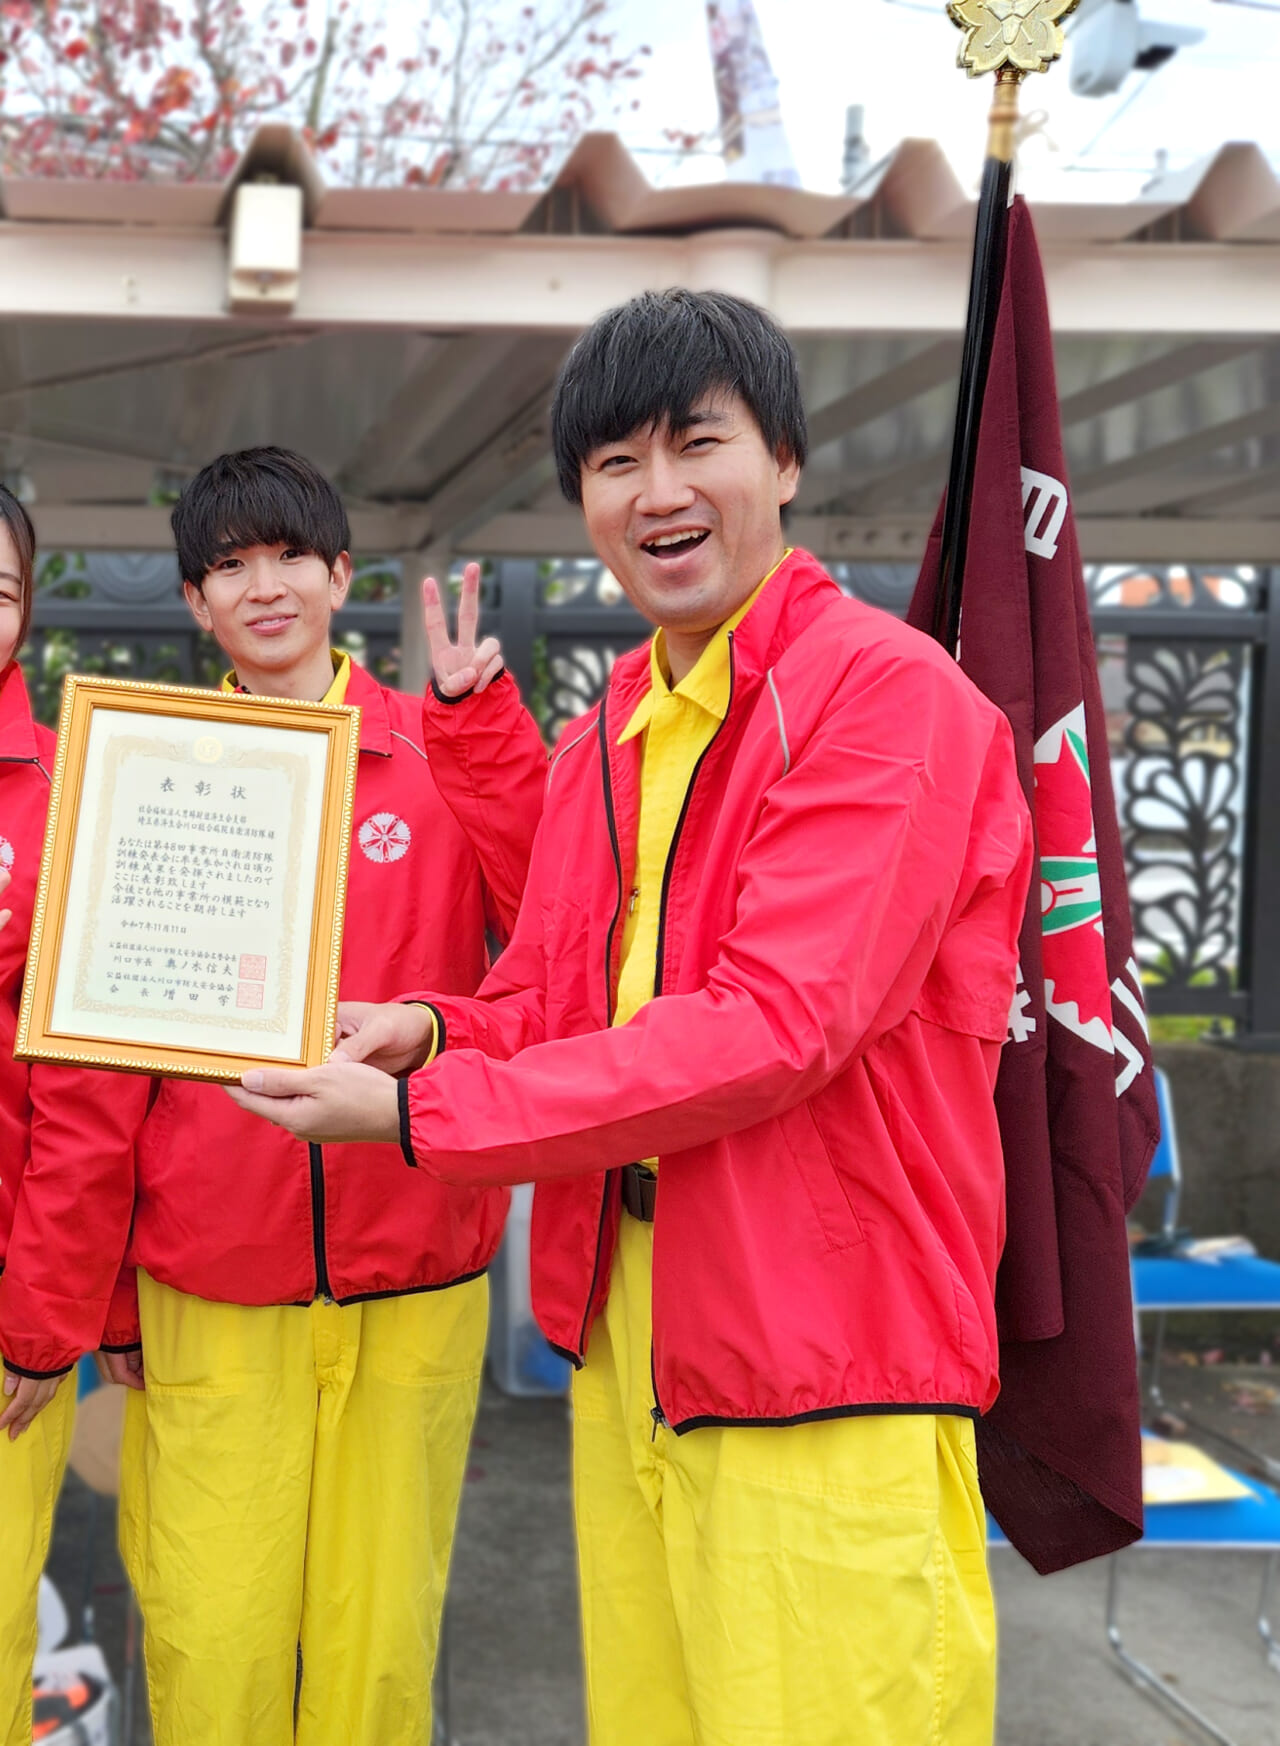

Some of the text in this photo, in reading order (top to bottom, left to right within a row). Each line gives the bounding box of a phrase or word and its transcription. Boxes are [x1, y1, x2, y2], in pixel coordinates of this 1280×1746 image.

[160, 776, 247, 799] 表彰状
[115, 860, 272, 886] 訓練成果を発揮されましたので
[111, 895, 246, 918] 活躍されることを期待します
